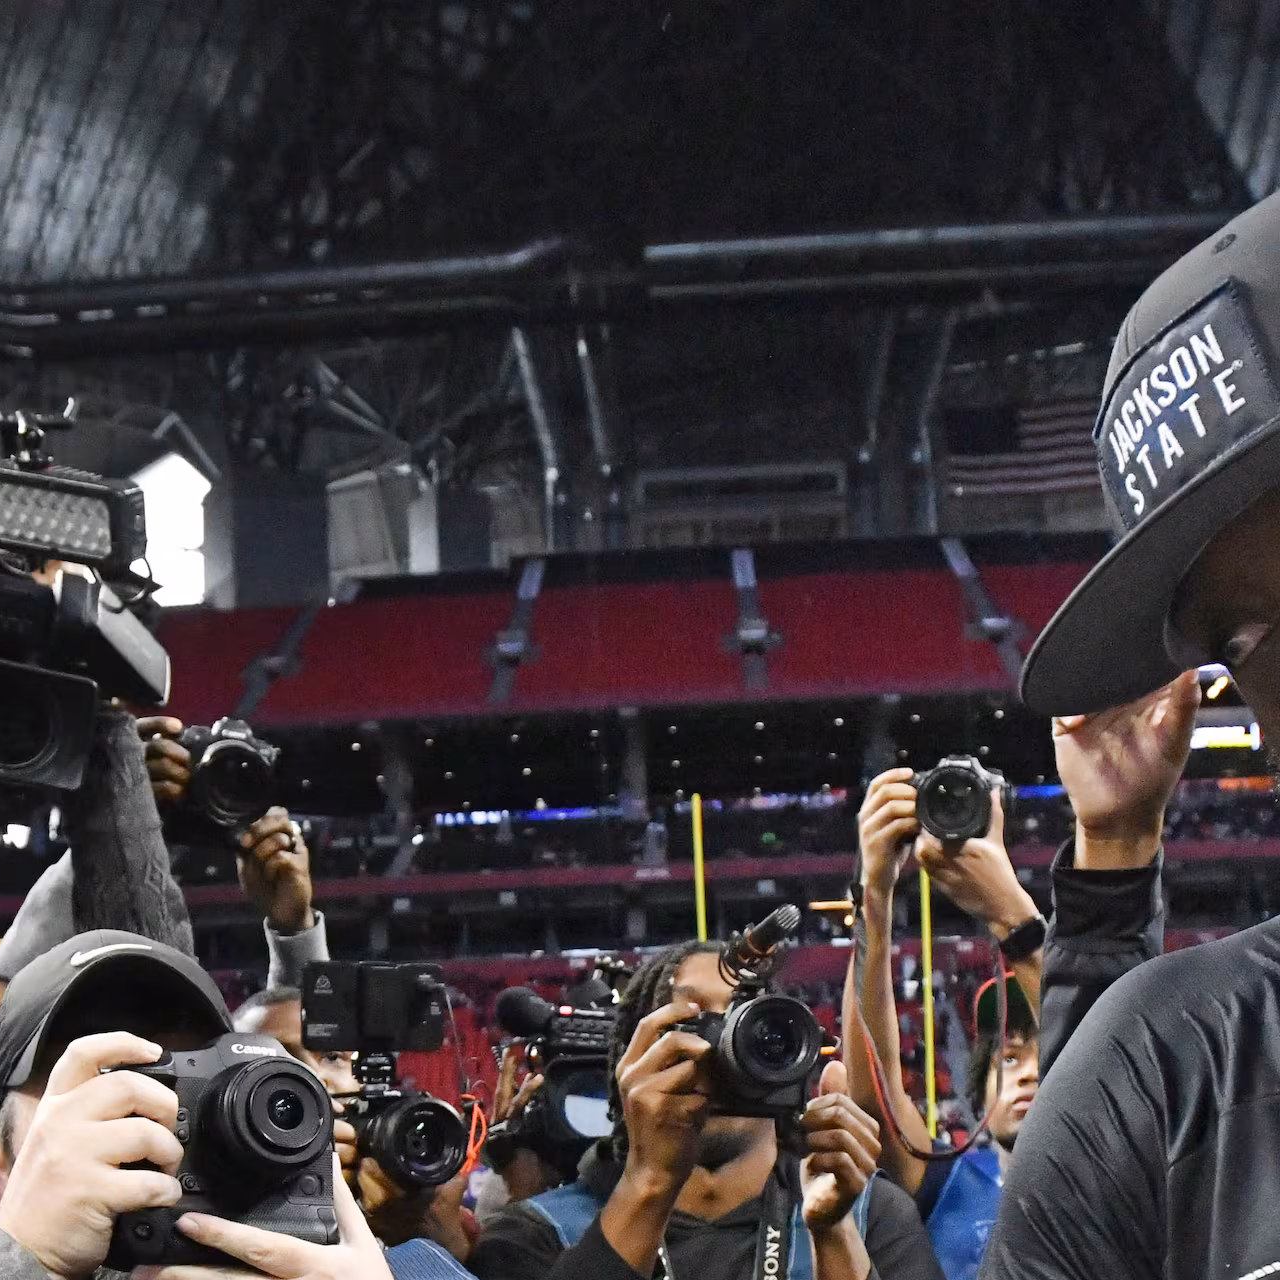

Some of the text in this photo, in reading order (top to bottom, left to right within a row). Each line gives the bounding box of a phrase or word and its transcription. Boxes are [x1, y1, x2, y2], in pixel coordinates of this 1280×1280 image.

[1108, 323, 1225, 474] JACKSON
[1125, 366, 1246, 516] STATE
[231, 1043, 277, 1056] Canon
